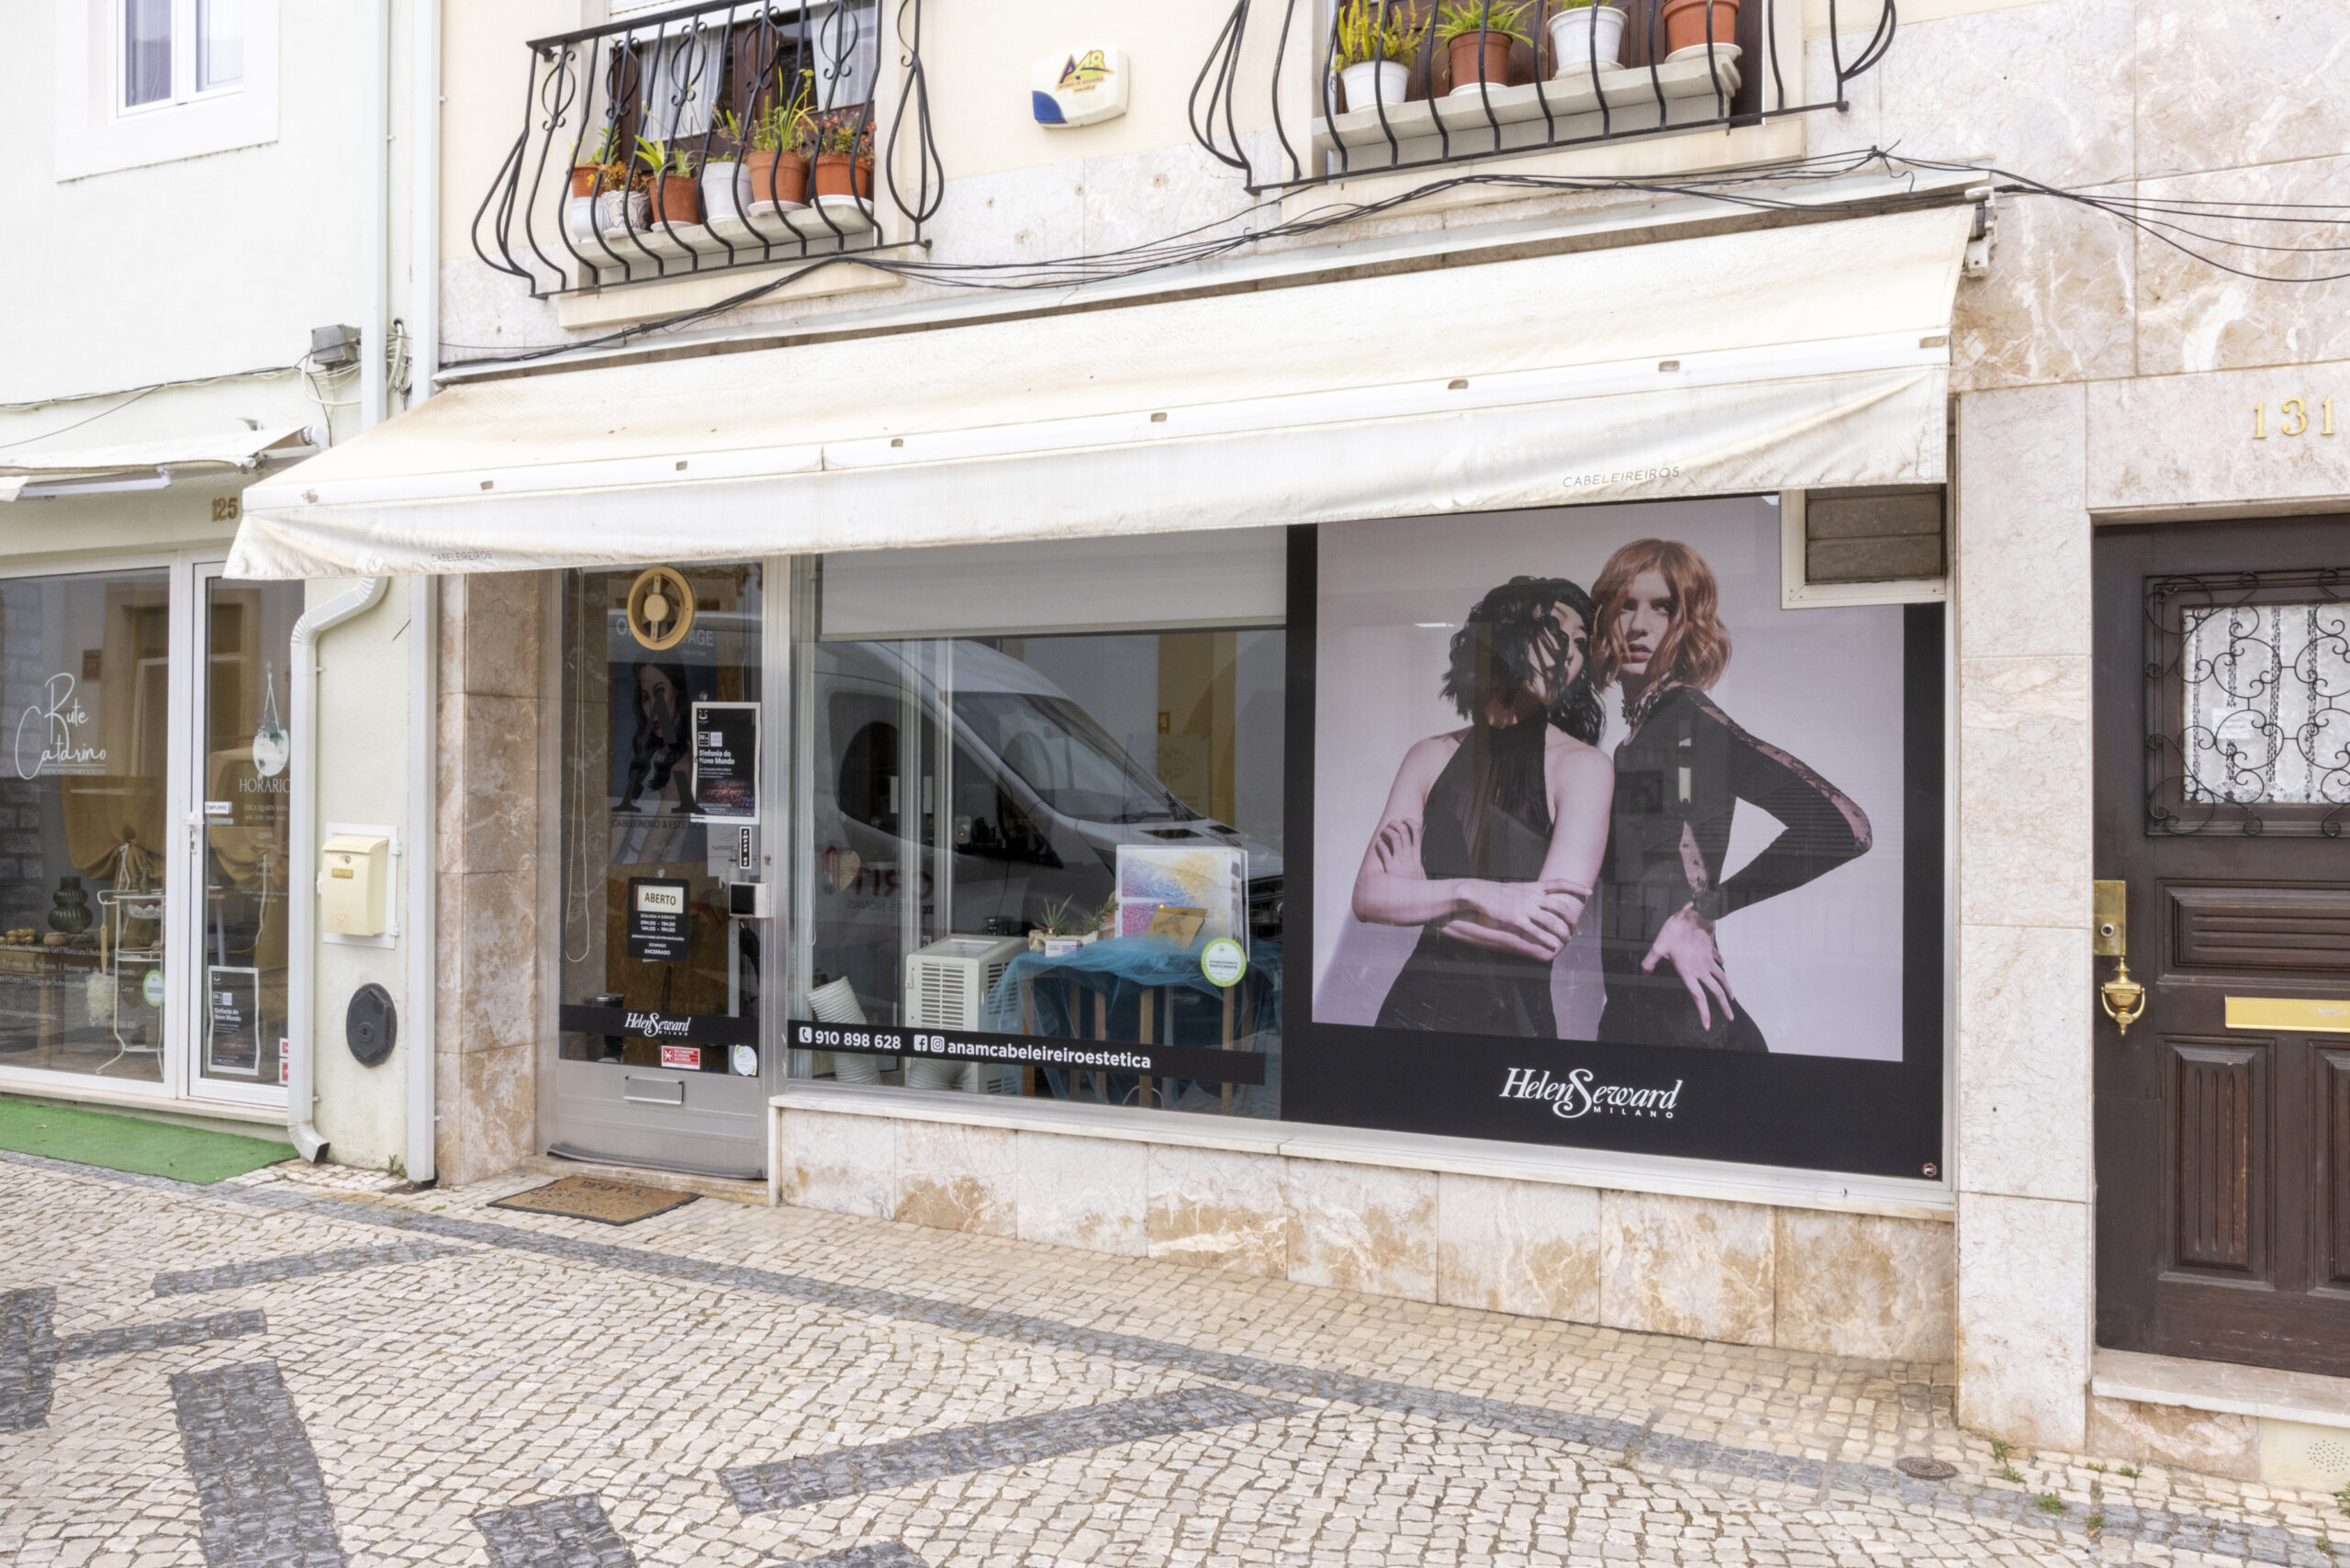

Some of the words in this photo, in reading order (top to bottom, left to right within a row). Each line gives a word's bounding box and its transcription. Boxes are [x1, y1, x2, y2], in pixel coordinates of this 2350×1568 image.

[2253, 396, 2335, 440] 131
[1562, 465, 1681, 487] CABELEIREIROS
[211, 498, 239, 521] 125
[430, 550, 493, 563] CABELEIREIROS
[44, 672, 89, 745] Rute
[698, 749, 723, 757] Sinfonia
[715, 757, 735, 766] Mundo
[644, 891, 677, 906] ABERTO
[815, 1031, 839, 1046] 910
[843, 1033, 870, 1047] 898
[874, 1035, 901, 1049] 628
[947, 1040, 1151, 1069] anamcabeleireiroestetica
[1593, 1105, 1674, 1119] MILANO
